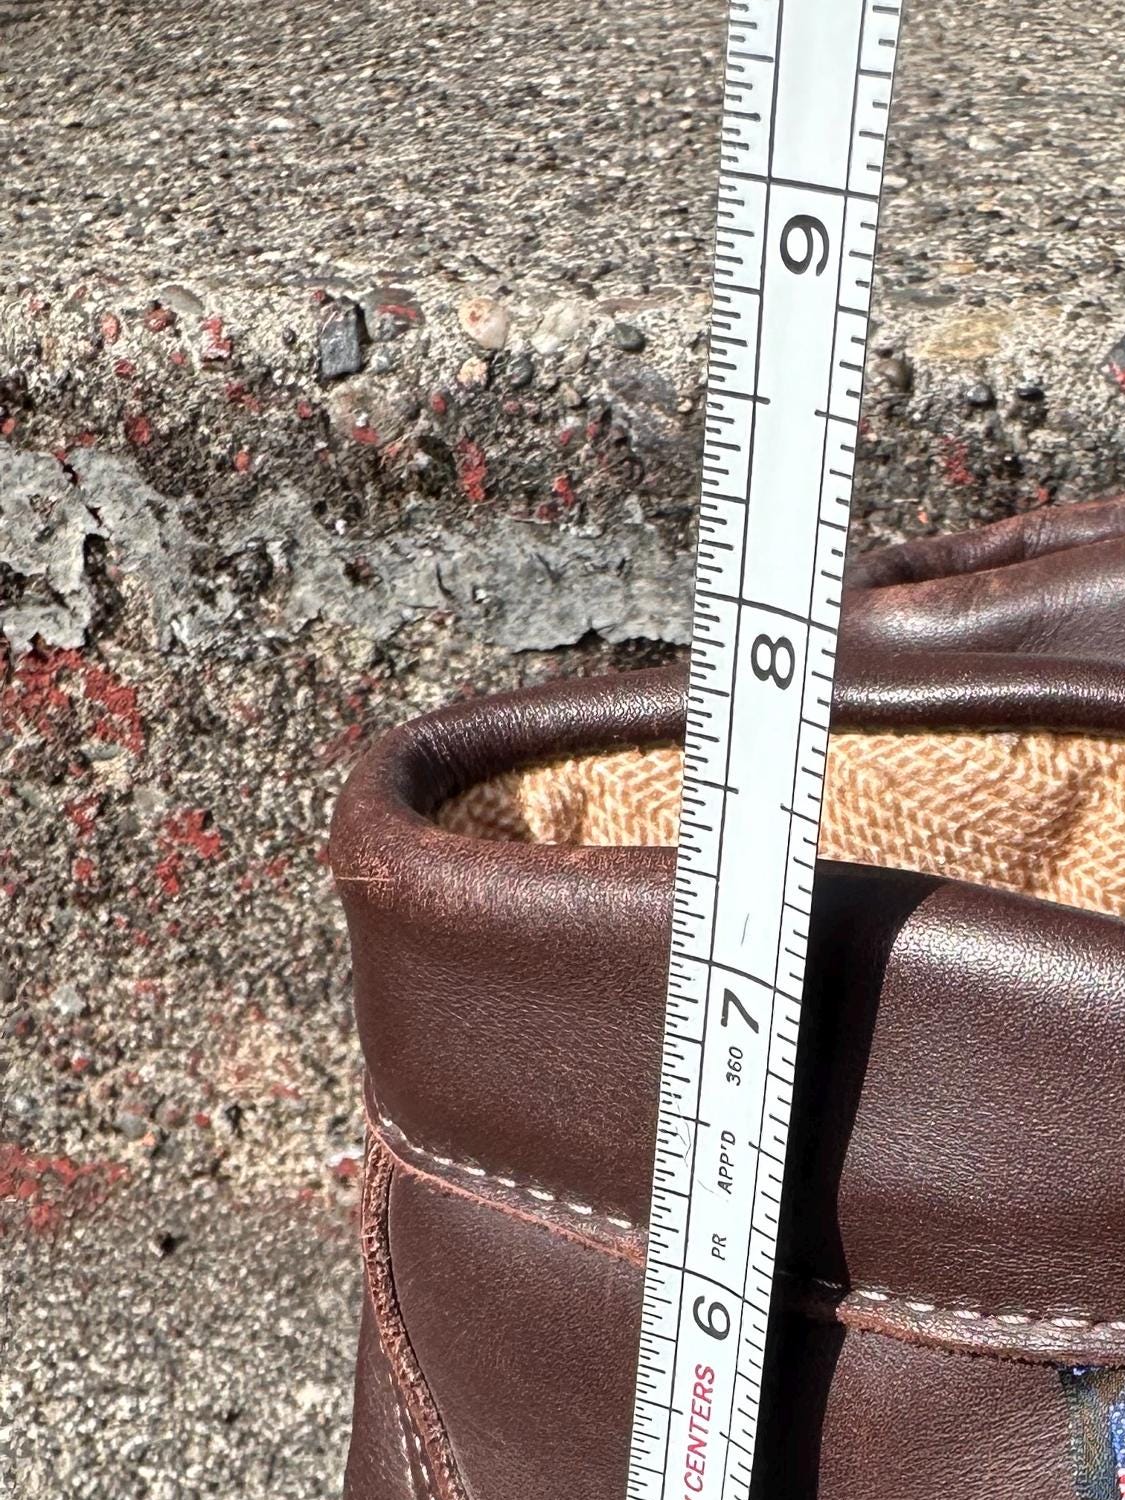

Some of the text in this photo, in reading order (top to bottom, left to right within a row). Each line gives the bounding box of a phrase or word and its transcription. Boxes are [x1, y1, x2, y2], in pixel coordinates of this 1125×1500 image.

[780, 214, 829, 277] 9
[751, 634, 795, 690] 8
[721, 988, 759, 1034] 7
[711, 1046, 744, 1261] PR APP'D 360
[693, 1295, 731, 1341] 6
[683, 1364, 715, 1492] CENTERS
